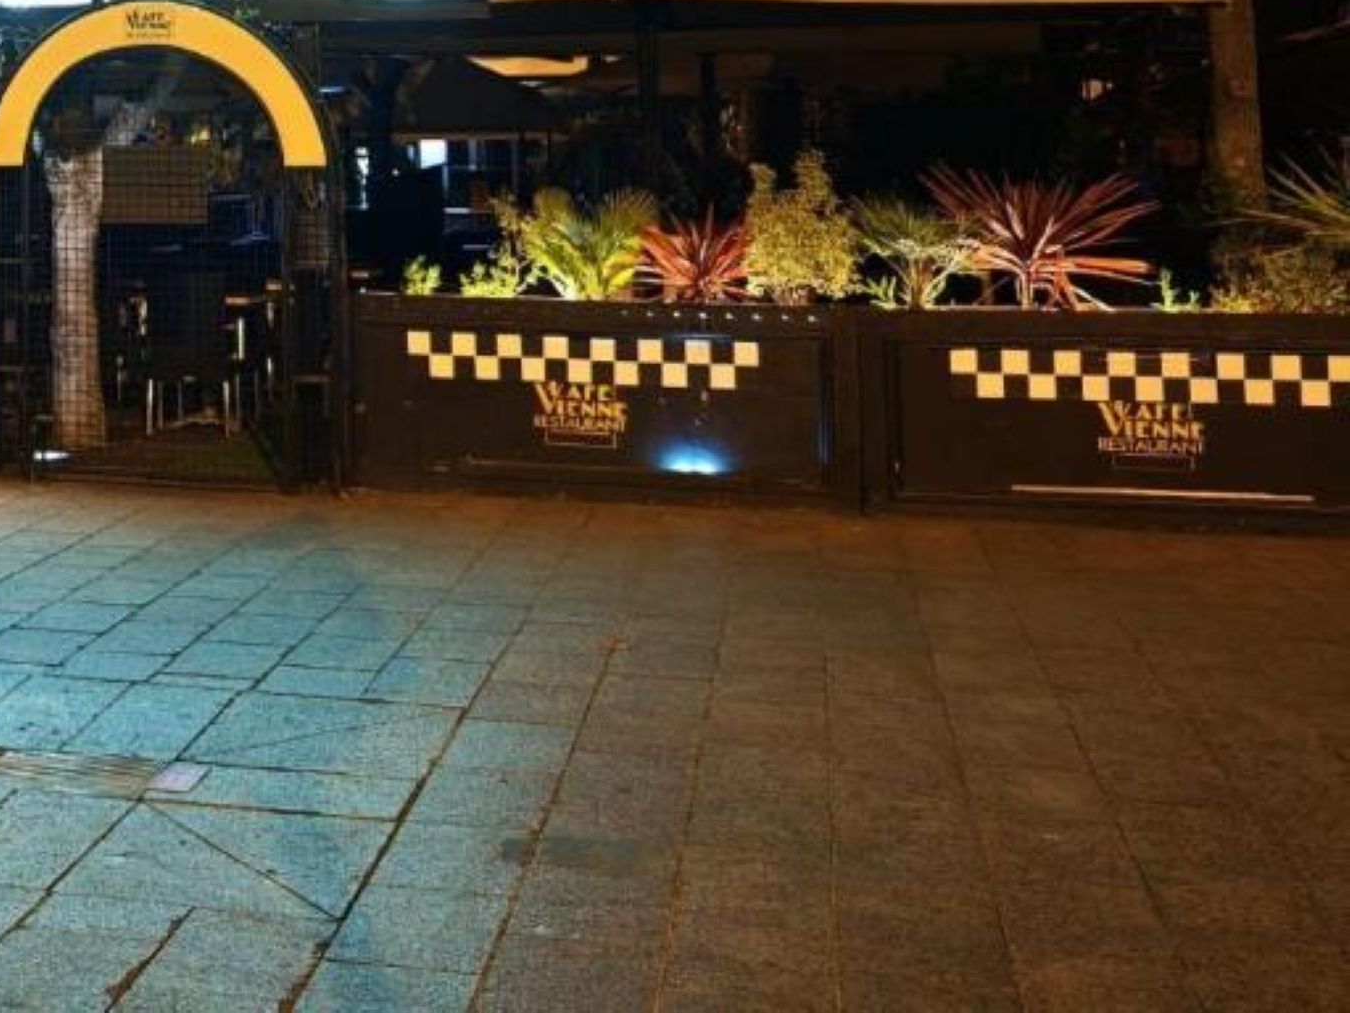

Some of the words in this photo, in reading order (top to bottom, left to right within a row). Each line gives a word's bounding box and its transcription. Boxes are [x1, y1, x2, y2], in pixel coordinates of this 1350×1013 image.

[536, 384, 627, 417] VIENNE
[1098, 402, 1205, 438] VIENNE
[1098, 437, 1205, 454] RESTAURANT
